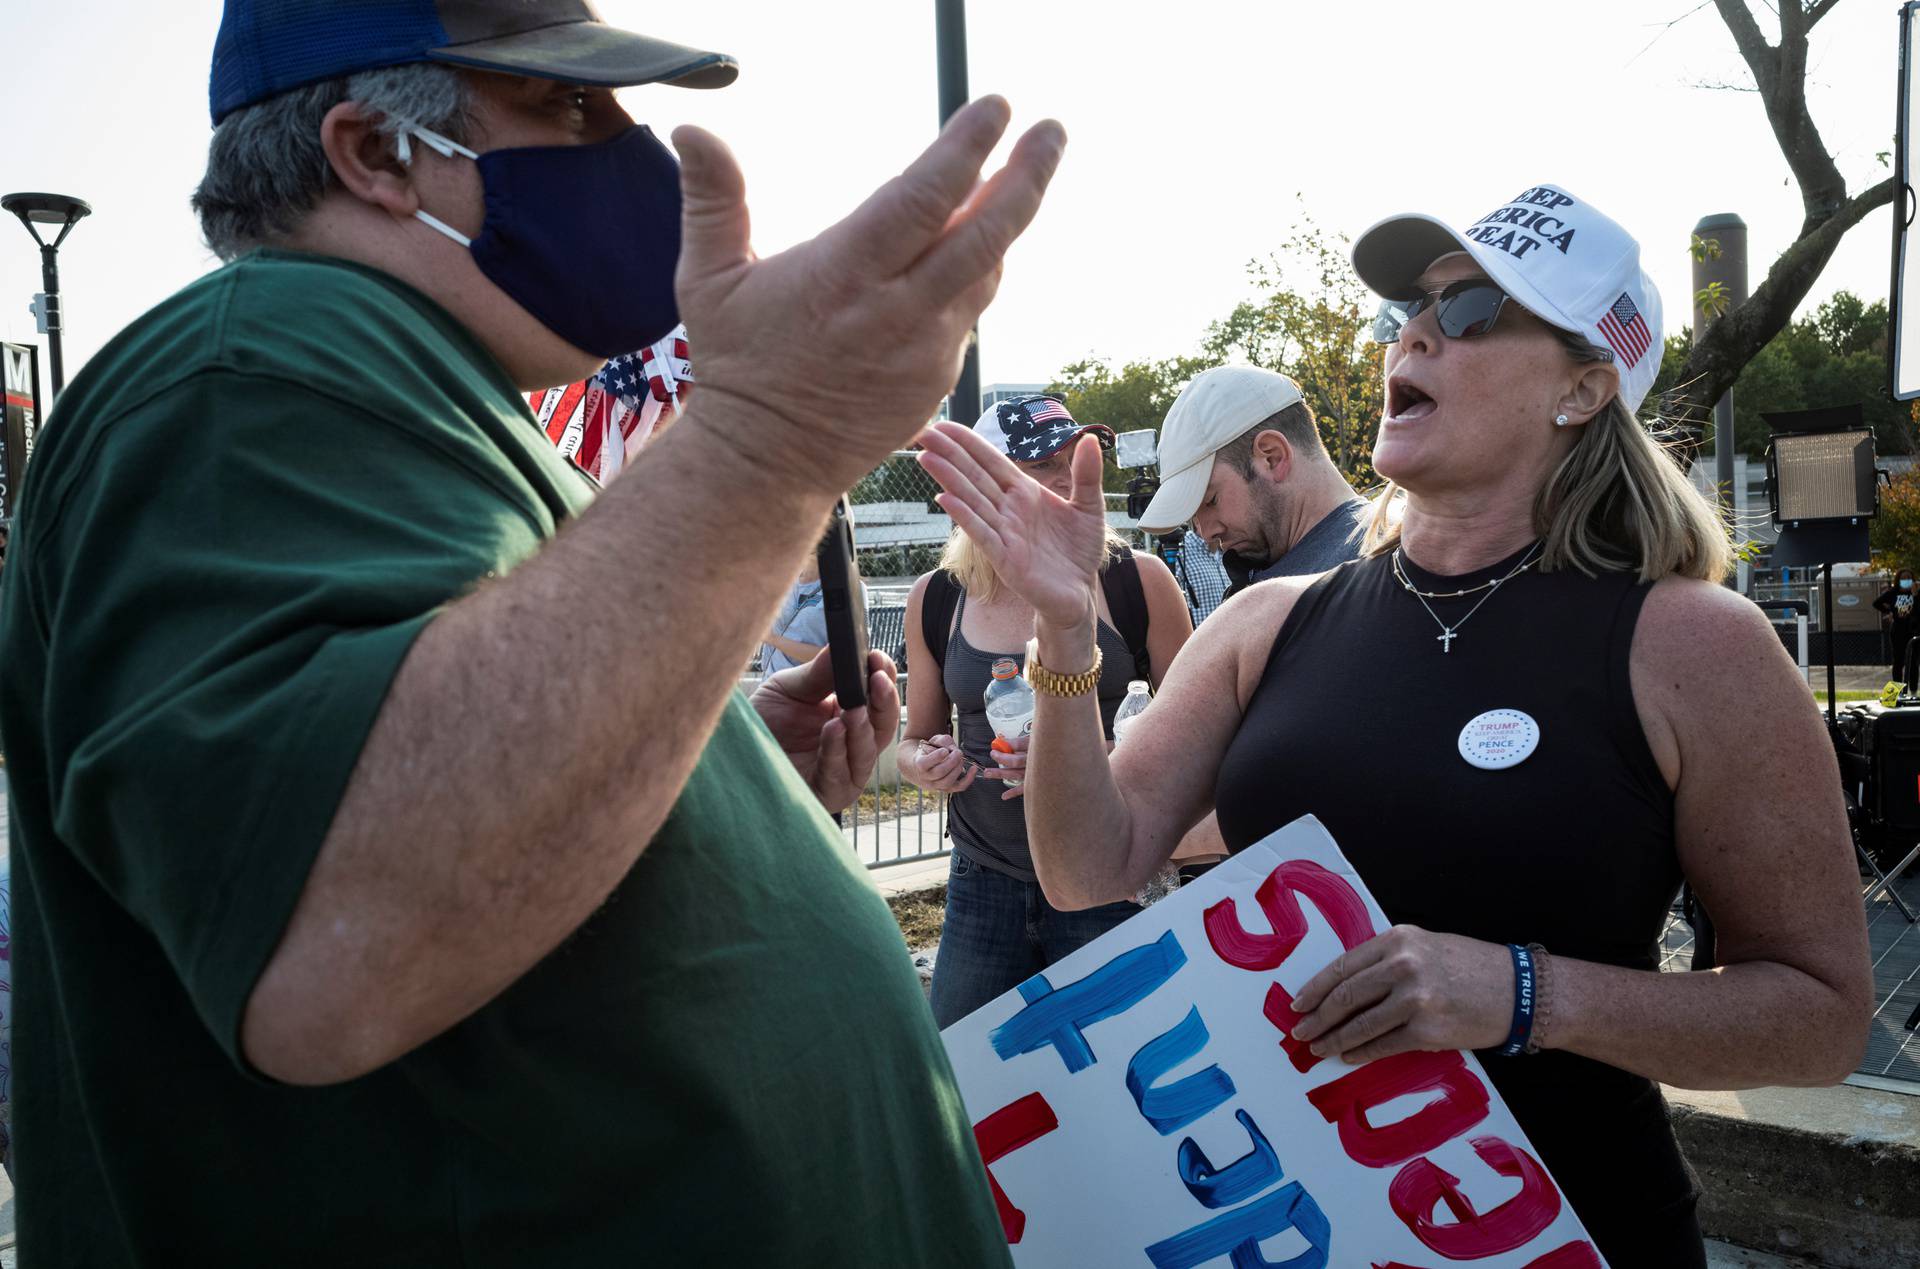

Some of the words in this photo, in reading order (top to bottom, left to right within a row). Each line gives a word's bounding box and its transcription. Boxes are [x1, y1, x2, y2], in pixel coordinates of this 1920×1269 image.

[1471, 207, 1576, 255] ERICA
[3, 347, 31, 394] M
[1480, 723, 1519, 731] TRUMP
[1518, 952, 1529, 967] WE
[1521, 973, 1531, 1014] TRUST
